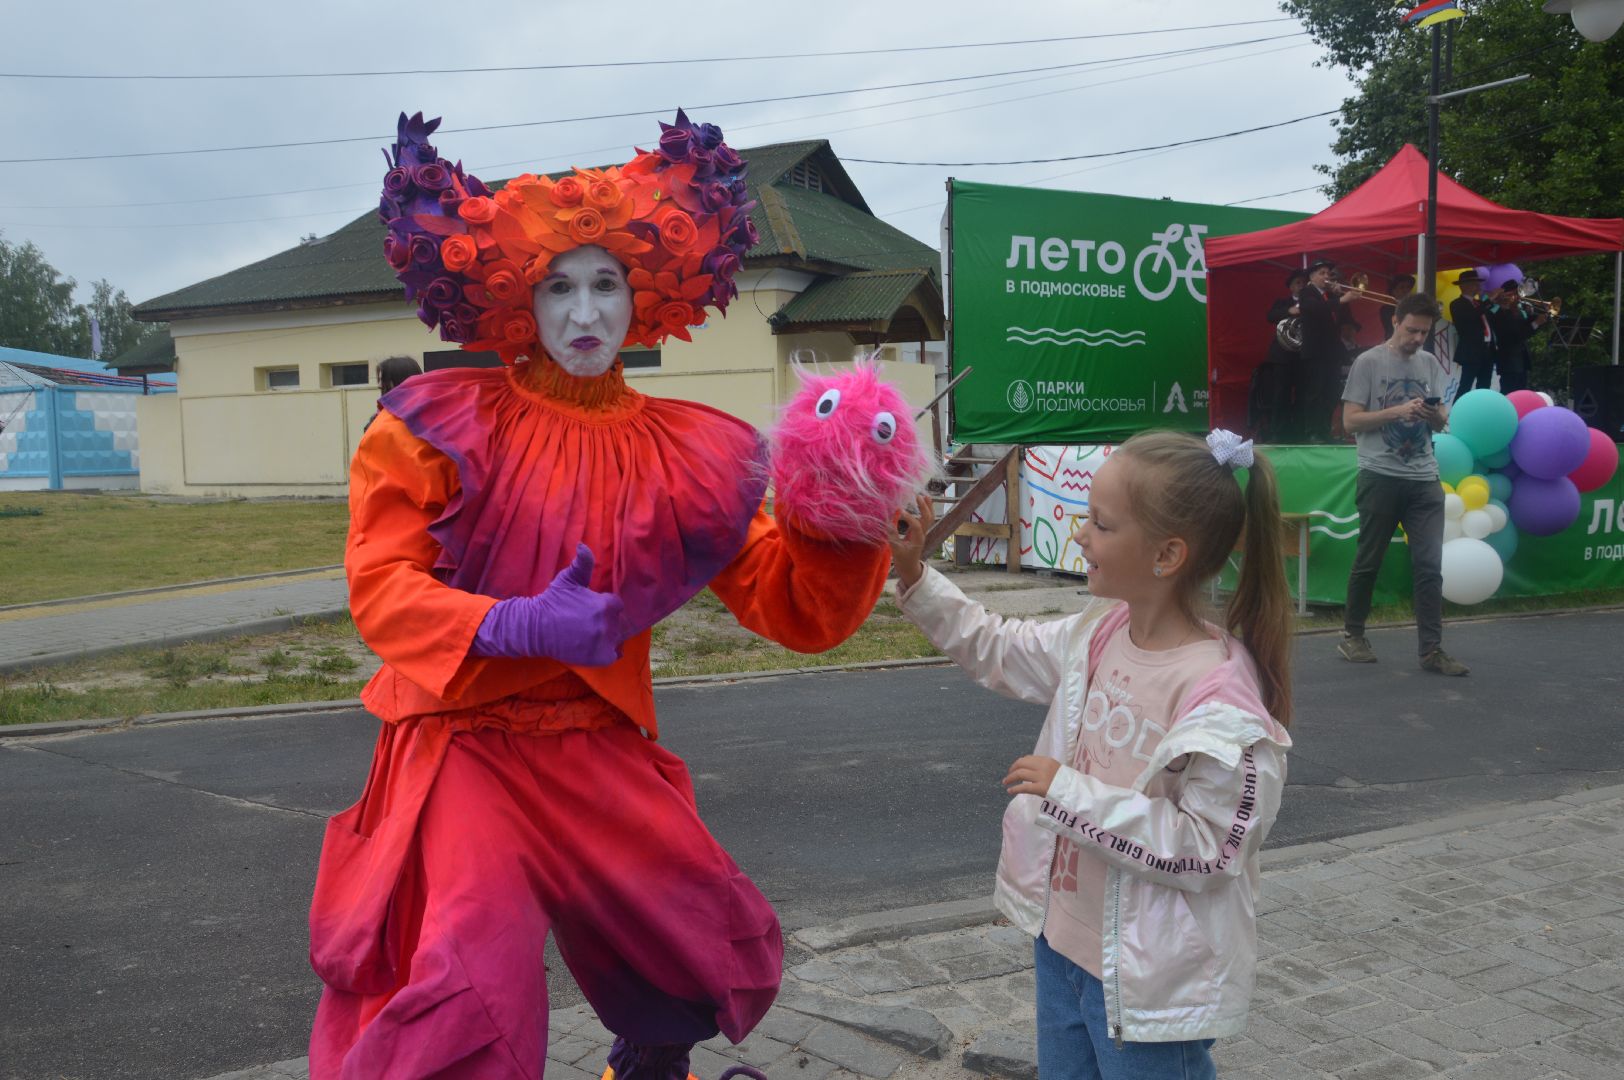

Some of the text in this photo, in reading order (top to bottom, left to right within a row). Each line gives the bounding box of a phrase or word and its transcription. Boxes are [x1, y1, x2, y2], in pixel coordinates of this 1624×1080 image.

[1020, 280, 1126, 298] ПОДМОСКОВЬЕ
[1036, 381, 1085, 395] ПАРКИ
[1193, 390, 1209, 400] ПА
[1036, 398, 1146, 412] ПОДМОСКОВЬЯ
[1595, 544, 1624, 562] ПОД
[1083, 690, 1169, 762] OOD
[1236, 744, 1257, 822] FUTURINO
[1109, 833, 1144, 860] GIRL
